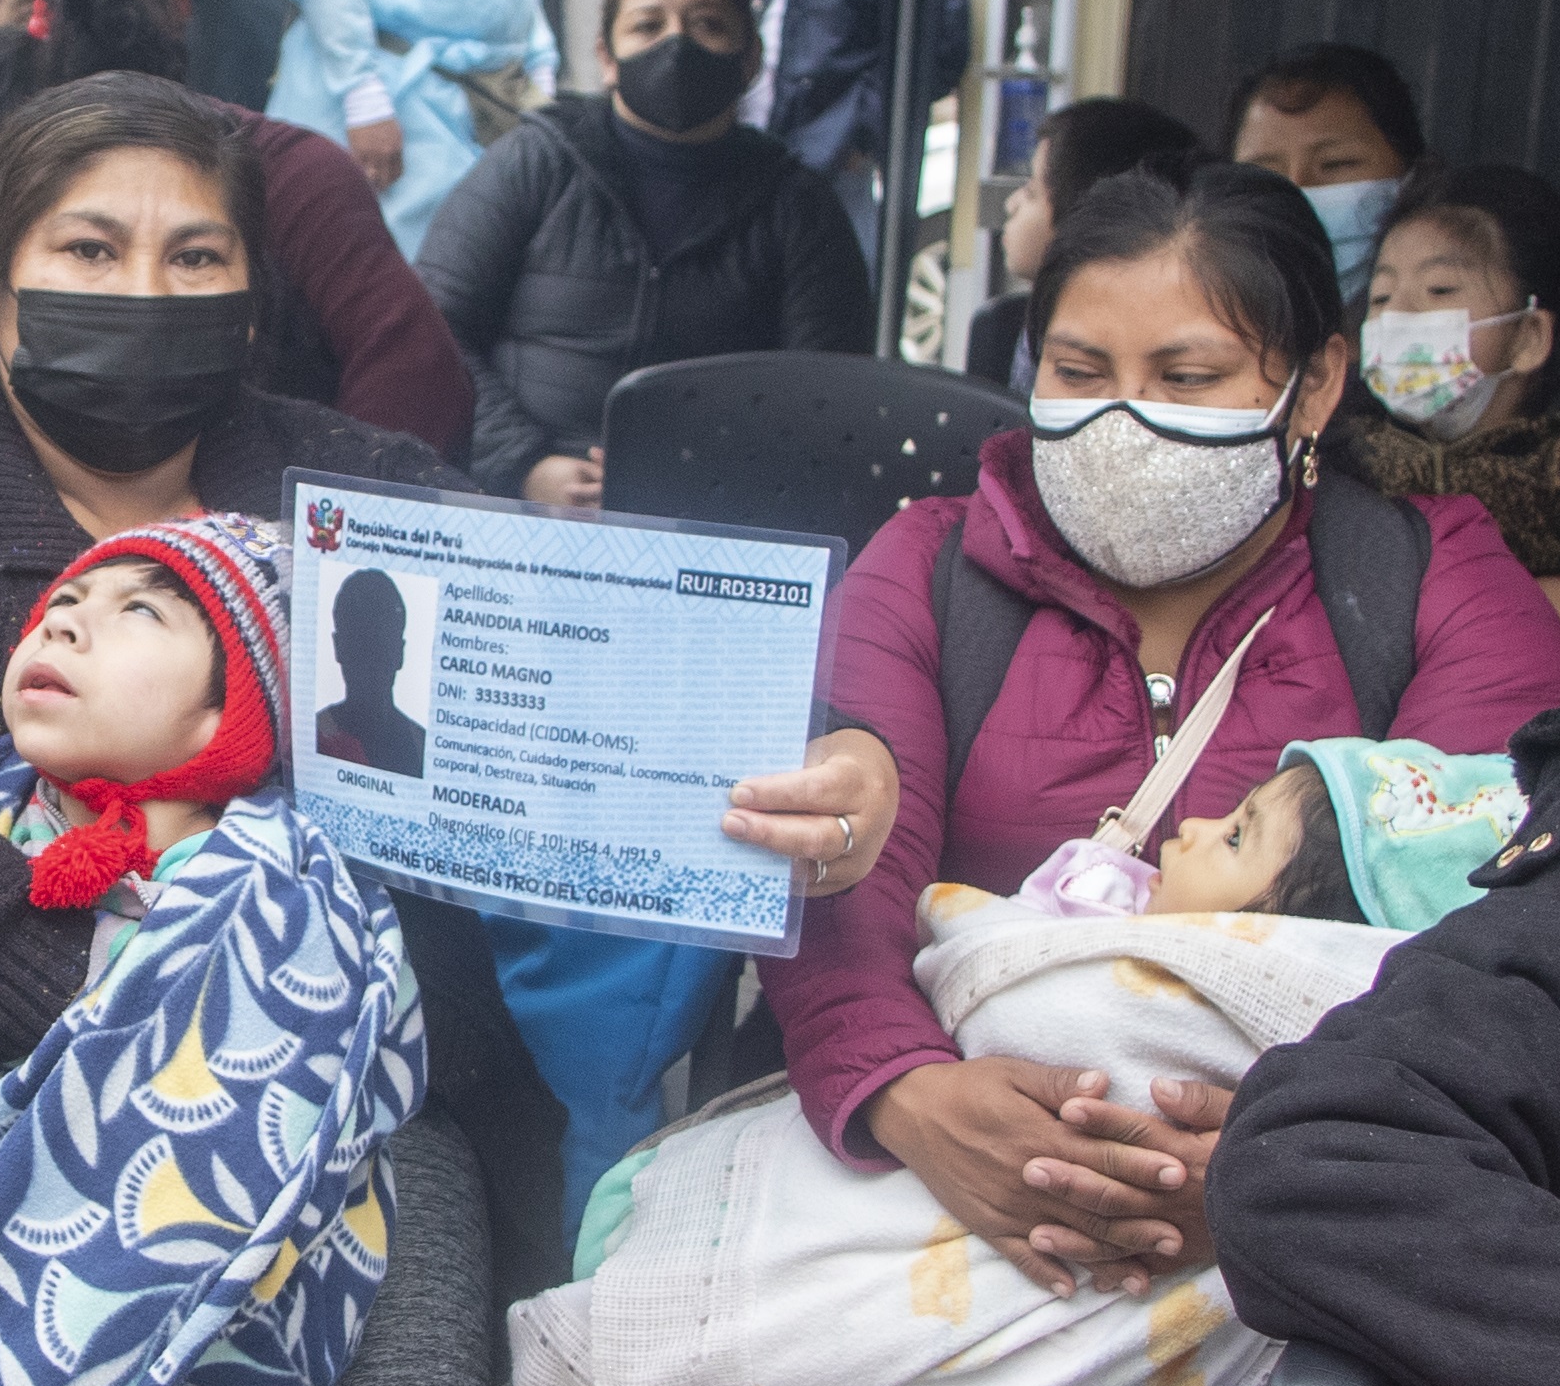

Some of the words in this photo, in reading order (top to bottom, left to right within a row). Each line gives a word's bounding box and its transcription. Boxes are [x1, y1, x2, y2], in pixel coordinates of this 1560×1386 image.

[347, 518, 407, 541] República
[410, 528, 430, 544] del
[433, 530, 463, 549] Perú
[346, 537, 380, 553] Consejo
[382, 542, 422, 558] Nacional
[423, 549, 445, 562] para
[447, 551, 456, 563] la
[458, 553, 513, 571] Integración
[515, 560, 527, 573] de
[530, 563, 538, 575] la
[541, 564, 581, 580] Persona
[584, 571, 603, 583] con
[605, 571, 672, 591] Discapacidad
[444, 582, 514, 606] Apellidos:
[443, 607, 523, 632] ARANDDIA
[527, 619, 610, 644] HILARIOOS
[441, 631, 510, 655] Nombres:
[440, 655, 487, 676] CARLO
[491, 663, 553, 685] MAGNO
[437, 682, 466, 701] DNI:
[475, 687, 546, 711] 33333333
[436, 708, 526, 736] Discapacidad
[530, 723, 640, 755] (CIDDM-OMS):
[433, 756, 482, 778] corporal,
[484, 765, 538, 786] Destreza,
[541, 773, 597, 793] Situación
[434, 735, 516, 763] Comunicación,
[519, 749, 568, 769] Cuidado
[570, 758, 627, 778] personal,
[630, 765, 708, 788] Locomoción,
[337, 768, 395, 796] ORIGINAL
[432, 785, 527, 817] MODERADA
[428, 811, 506, 842] Diagnóstico
[508, 826, 535, 848] (CIE
[540, 832, 568, 853] 10):
[570, 839, 615, 861] H54.4,
[619, 845, 662, 864] H91.9
[369, 839, 421, 869] CARNÉ
[425, 855, 448, 875] DE
[451, 862, 539, 894] REGISTRO
[544, 880, 581, 903] DEL
[586, 887, 674, 914] CONADIS
